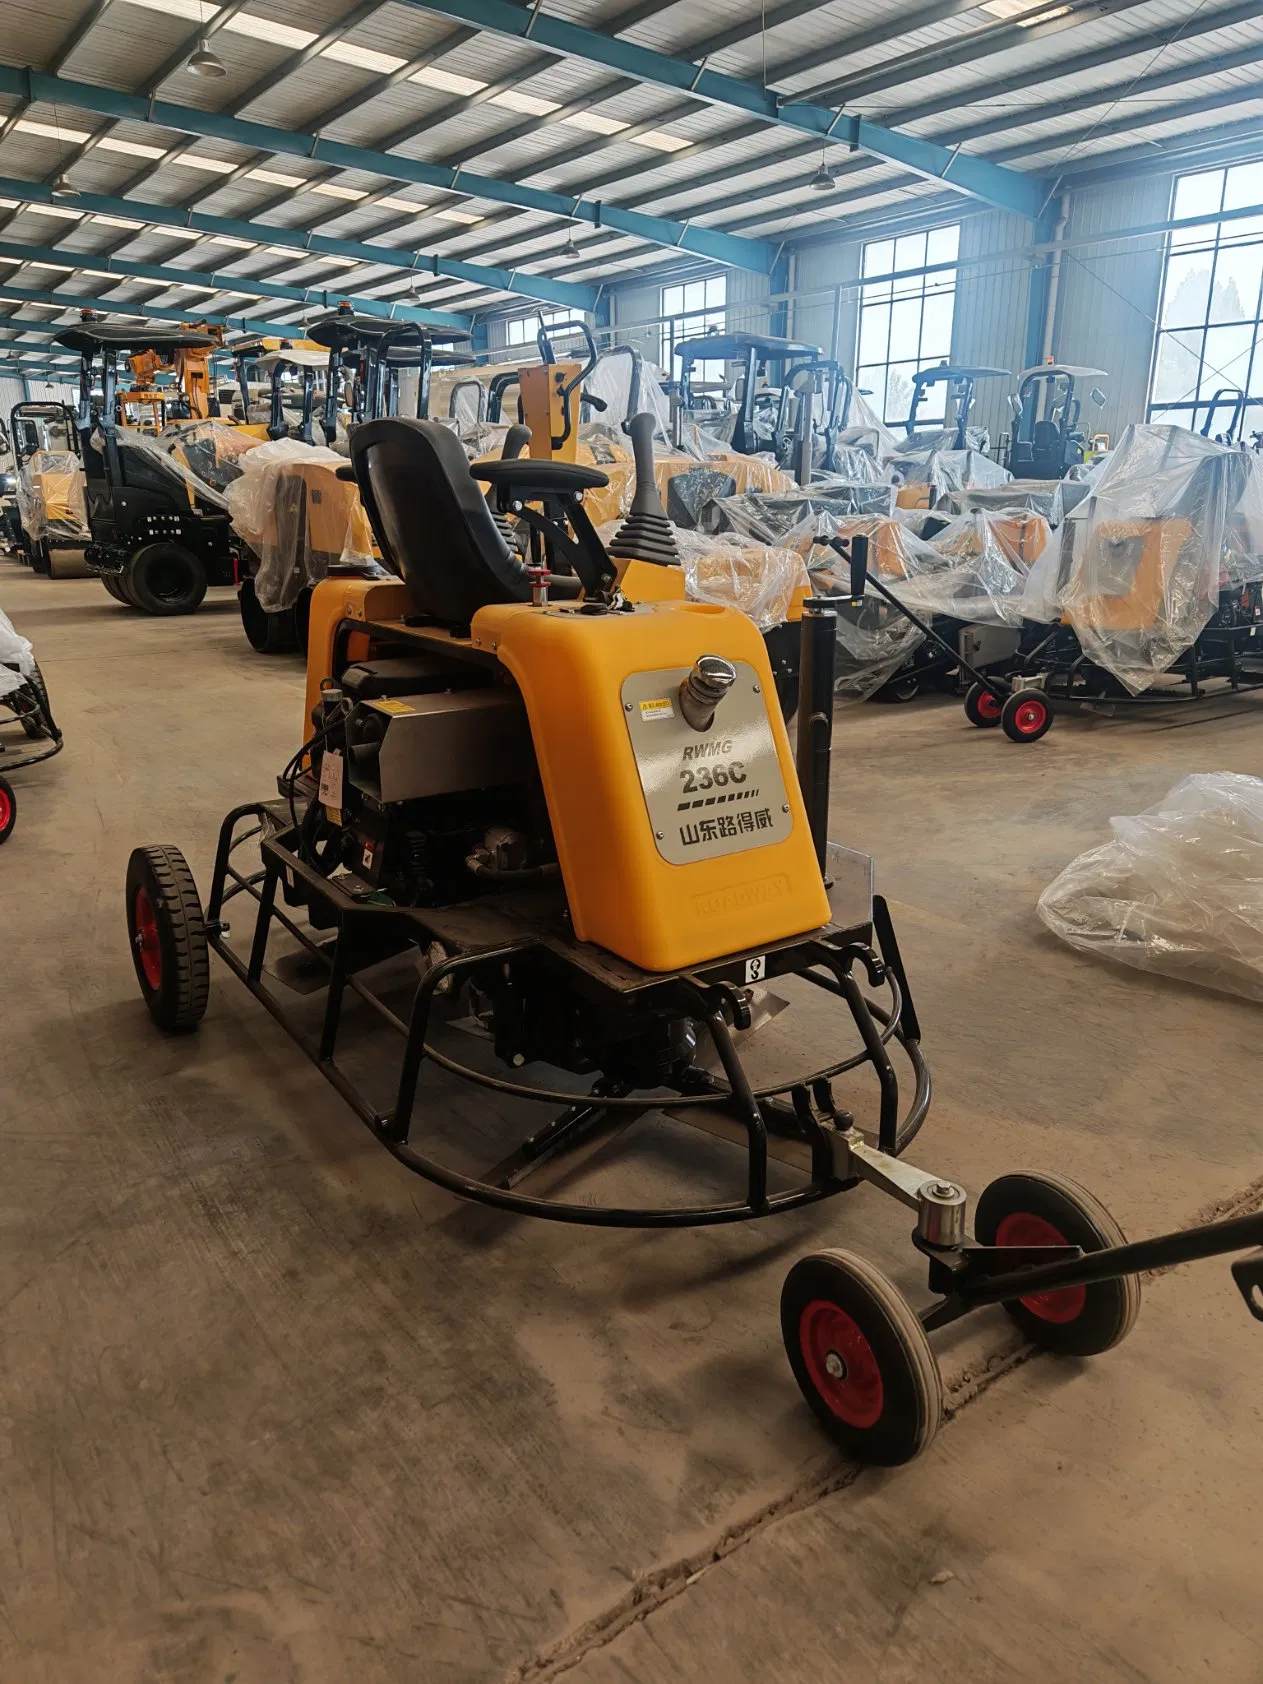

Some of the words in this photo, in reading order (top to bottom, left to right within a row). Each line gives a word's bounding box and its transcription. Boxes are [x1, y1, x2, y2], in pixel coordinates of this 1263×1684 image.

[682, 740, 733, 761] RWMG
[680, 761, 747, 794] 236C
[679, 808, 774, 846] 山东路得威
